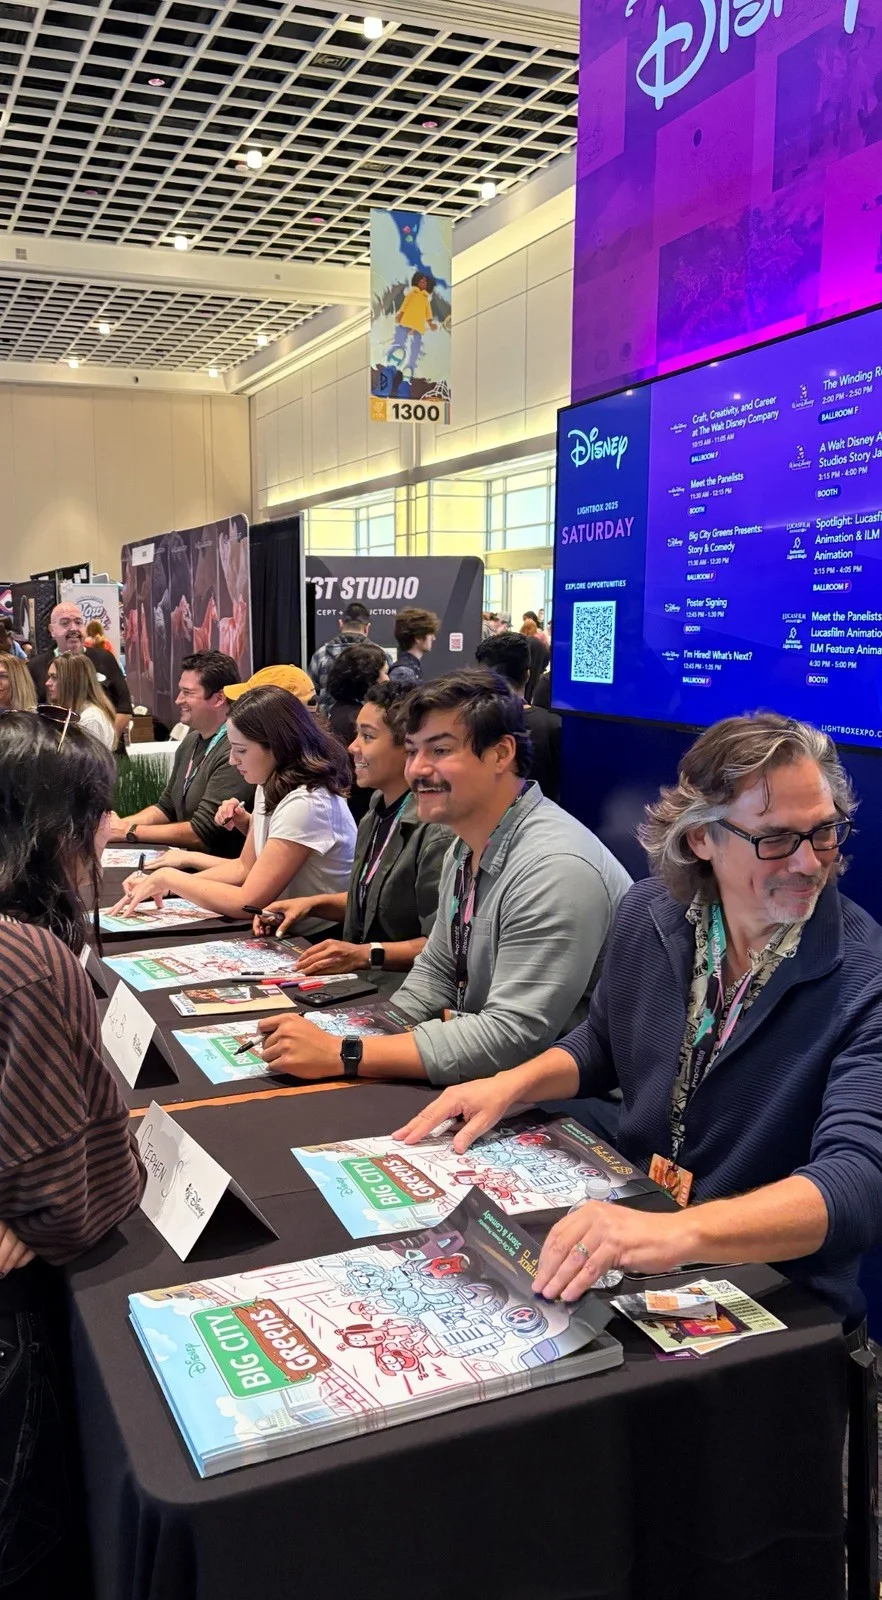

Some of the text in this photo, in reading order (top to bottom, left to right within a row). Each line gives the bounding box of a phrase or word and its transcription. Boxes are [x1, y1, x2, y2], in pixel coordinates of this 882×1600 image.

[823, 366, 882, 390] The Winding R
[822, 395, 834, 404] 2:00
[835, 392, 844, 401] PM
[849, 388, 862, 398] 2:50
[863, 385, 872, 394] PM
[392, 404, 440, 421] 1300
[692, 397, 776, 424] Craft, Creativity, and Career
[822, 406, 858, 422] BALLROOM F
[692, 429, 698, 437] at
[699, 426, 710, 435] The
[711, 421, 724, 432] Walt
[726, 418, 746, 430] Disney
[748, 410, 779, 424] Company
[820, 442, 826, 453] A
[828, 438, 845, 451] Walt
[847, 436, 874, 448] Disney
[692, 452, 714, 463] BALLROOM
[819, 455, 847, 468] Studios
[849, 452, 870, 462] Story
[690, 472, 744, 488] Meet the Panelists
[818, 472, 830, 480] 3:15
[858, 466, 868, 474] PM
[818, 488, 838, 498] BOOTH
[576, 501, 618, 515] LIGHTBOX 2025
[690, 506, 705, 514] BOOTH
[562, 516, 634, 545] SATURDAY
[816, 514, 852, 531] Spotlight:
[689, 525, 762, 542] Big City Greens Presents:
[815, 529, 880, 544] Animation & ILM
[688, 541, 735, 555] Story & Comedy
[814, 549, 852, 560] Animation
[305, 576, 420, 600] ST STUDIO
[565, 580, 626, 590] EXPLORE OPPORTUNITIES
[813, 583, 844, 591] BALLROOM
[686, 598, 728, 608] Poster Signing
[812, 612, 830, 621] Meet
[833, 611, 845, 621] the
[810, 628, 844, 638] Lucasfilm
[684, 650, 692, 658] I'm
[694, 650, 712, 659] Hired!
[712, 650, 732, 660] What's
[734, 651, 752, 660] Next?
[810, 643, 824, 652] ILM
[826, 644, 854, 654] Feature
[712, 944, 721, 955] for
[712, 964, 721, 978] Art
[350, 1162, 402, 1206] BIG CITY
[482, 1210, 504, 1232] Comedy
[507, 1232, 522, 1250] Story
[518, 1256, 538, 1278] HTBOX
[206, 1314, 272, 1389] BIG CITY
[185, 1342, 207, 1378] Disney
